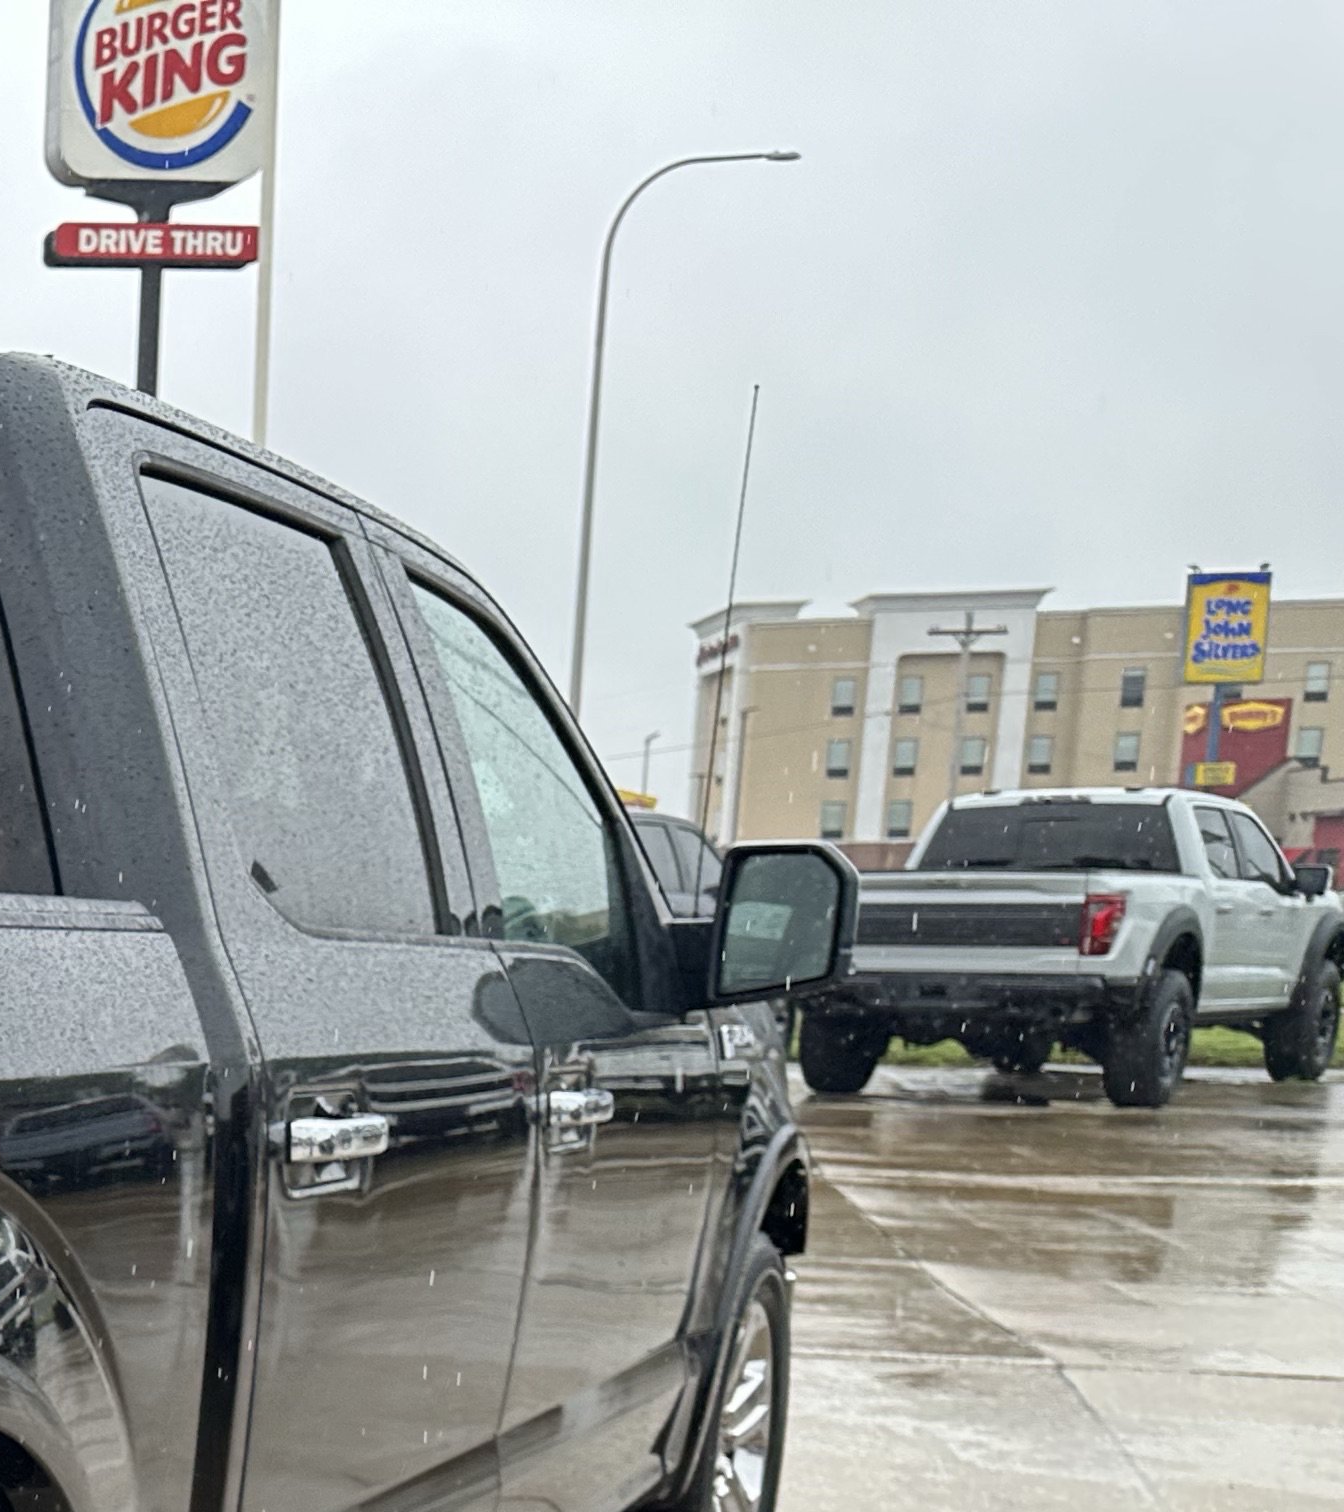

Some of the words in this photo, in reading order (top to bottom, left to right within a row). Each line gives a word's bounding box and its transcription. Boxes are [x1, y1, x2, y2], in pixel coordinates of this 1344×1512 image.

[95, 0, 243, 70] BURGER
[98, 33, 247, 127] KING
[78, 228, 163, 254] DRIVE
[170, 229, 243, 255] THRU
[1206, 599, 1252, 616] LONG
[1200, 618, 1252, 640] JOHN
